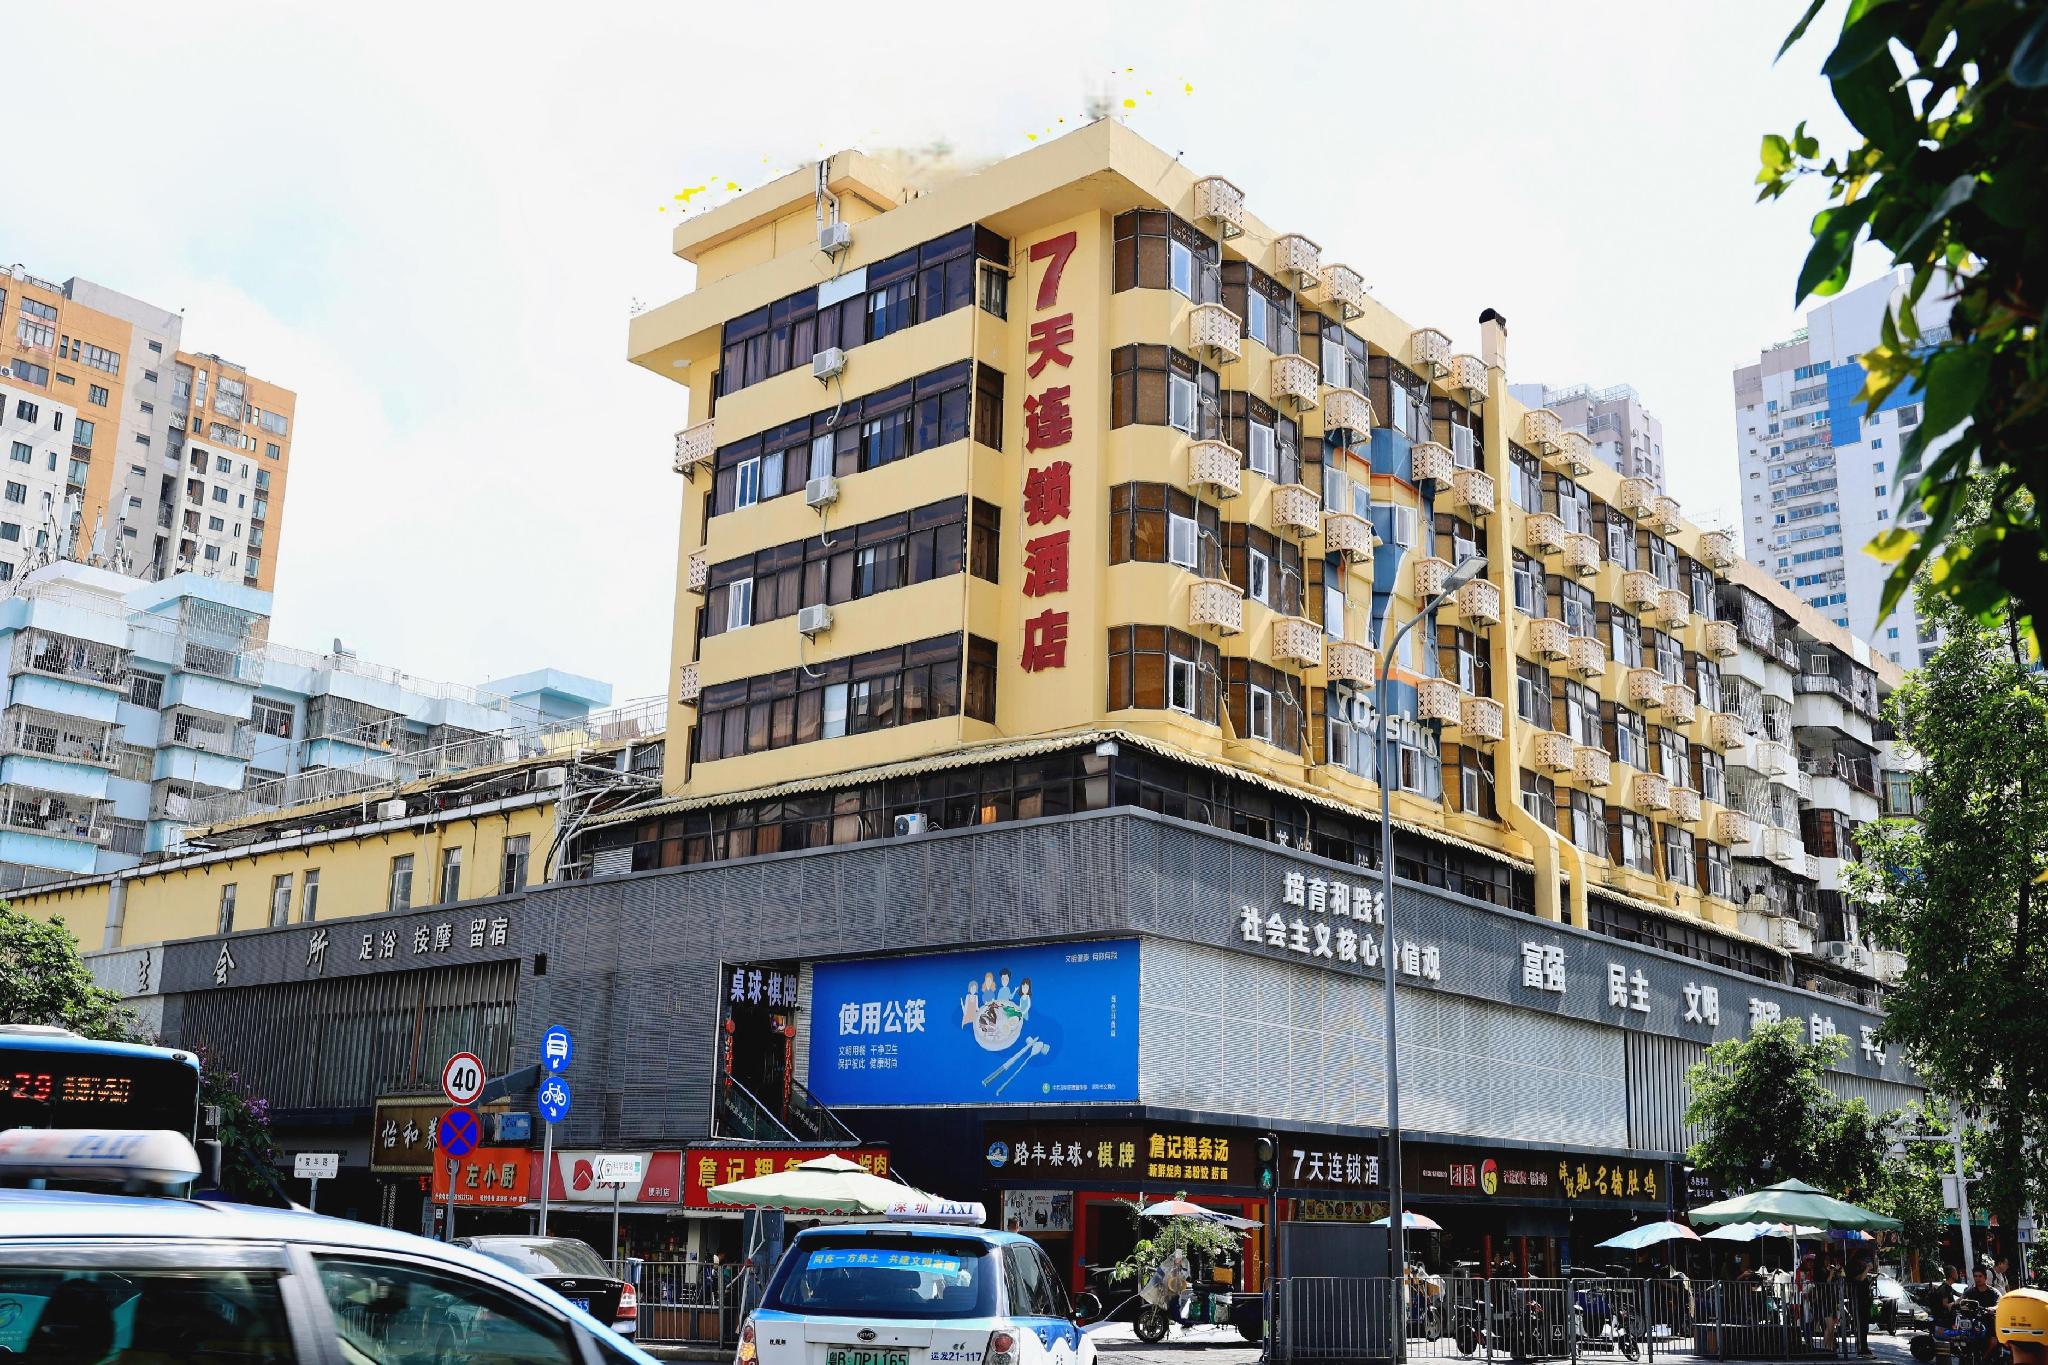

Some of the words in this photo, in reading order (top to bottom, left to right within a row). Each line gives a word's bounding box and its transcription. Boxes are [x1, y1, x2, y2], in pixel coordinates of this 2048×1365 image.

[1021, 231, 1076, 672] 7天连锁酒店
[359, 930, 397, 961] 足浴
[413, 923, 452, 955] 按摩
[470, 916, 508, 948] 留宿
[1240, 905, 1440, 981] 社会主义核心价值观
[1521, 941, 1567, 993] 富强
[1607, 963, 1651, 1013] 民主
[1682, 982, 1719, 1026] 文明
[838, 998, 926, 1036] 使用公筷
[838, 1046, 866, 1056] 文明用餐
[870, 1044, 898, 1056] 干净卫生
[869, 1057, 898, 1069] 健康时尚
[452, 1067, 476, 1092] 40
[1149, 1132, 1229, 1162] 詹记粿条汤
[466, 1162, 516, 1189] 左小厨
[648, 1187, 670, 1197] 便利店
[893, 1201, 929, 1214] 深圳
[938, 1203, 975, 1215] TAXI
[814, 1253, 879, 1264] 同在一方热土
[930, 1351, 982, 1362] 运发21-117
[952, 1342, 967, 1350] e6
